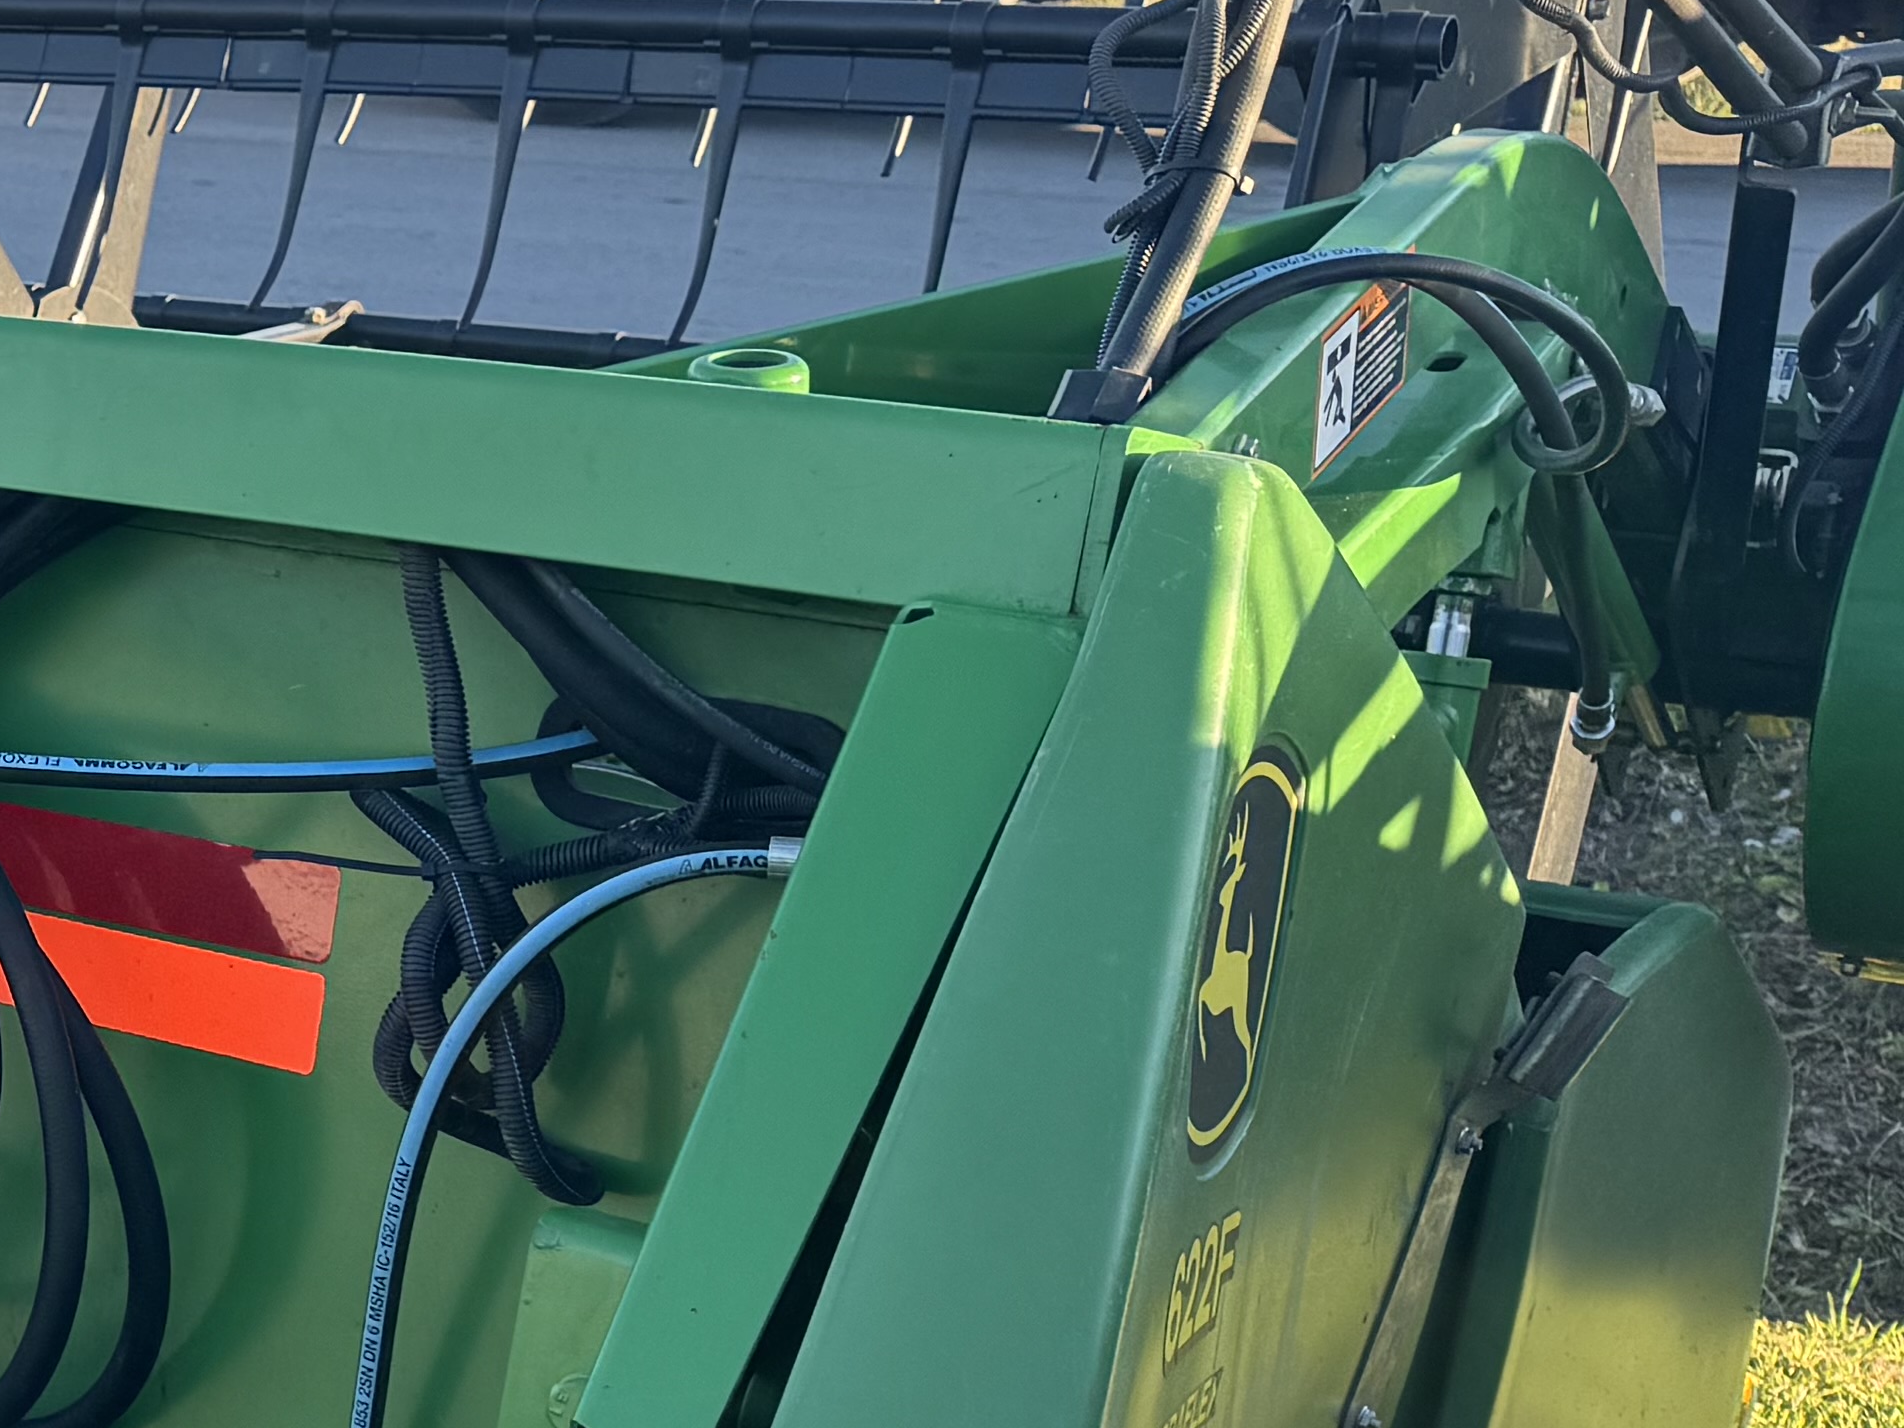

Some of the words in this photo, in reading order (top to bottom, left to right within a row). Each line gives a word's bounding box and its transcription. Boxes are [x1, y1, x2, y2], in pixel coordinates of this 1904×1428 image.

[390, 1156, 413, 1201] ITALY
[375, 1201, 401, 1272] IC-152/16
[368, 1274, 388, 1323] MSHA
[1163, 1209, 1242, 1364] 622F
[367, 1324, 380, 1337] 6
[363, 1339, 379, 1364] DN
[358, 1365, 375, 1398] 2SN
[353, 1398, 370, 1428] 853
